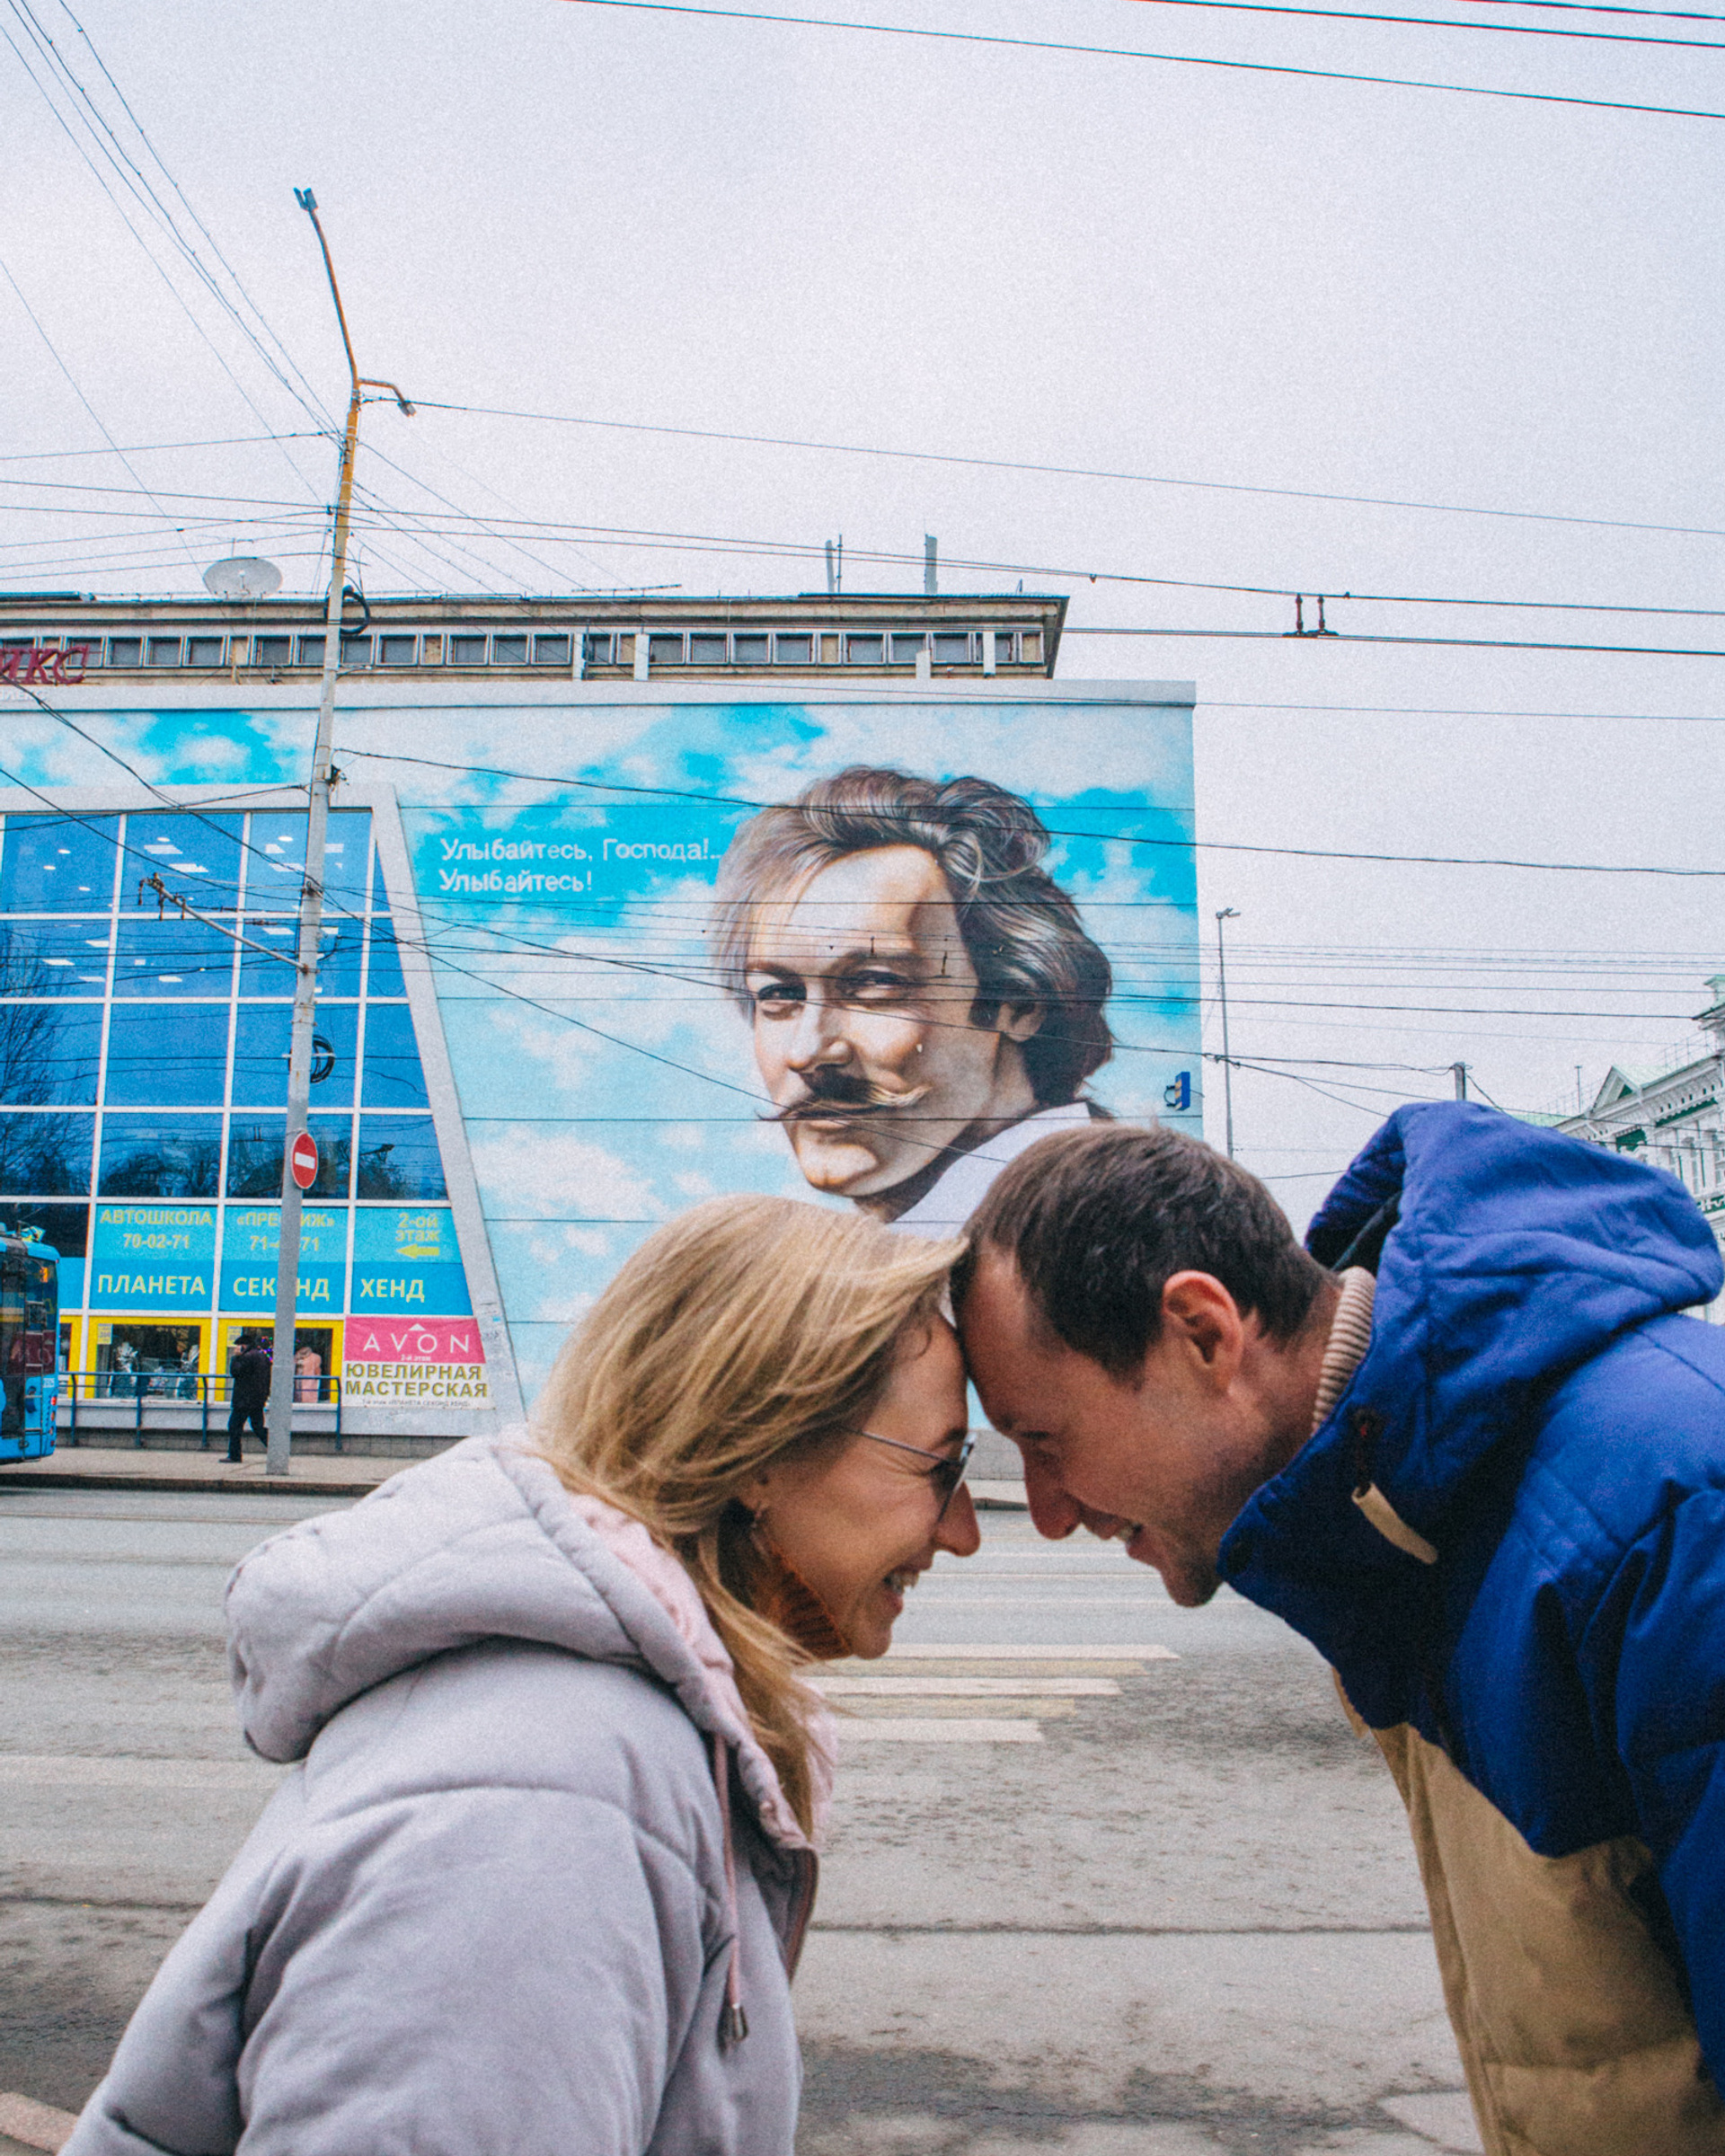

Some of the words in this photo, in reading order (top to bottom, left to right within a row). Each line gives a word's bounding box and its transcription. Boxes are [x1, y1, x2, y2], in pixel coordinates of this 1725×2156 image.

[439, 838, 593, 862] Улыбайтесь,
[438, 869, 592, 891] Улыбайтесь!
[100, 1209, 213, 1225] АВТОШКОЛА
[236, 1211, 335, 1227] «ПРЕИЖ»
[398, 1212, 438, 1228] 2-ой
[123, 1233, 190, 1249] 70-02-71
[395, 1229, 440, 1241] этаж
[98, 1275, 206, 1294] ПЛАНЕТА
[234, 1277, 330, 1302] СЕКНД
[360, 1278, 425, 1303] ХЕНД
[363, 1332, 469, 1354] AVON
[346, 1364, 482, 1380] ЮВЕЛИРНАЯ
[345, 1381, 487, 1397] МАСТЕРСКАЯ
